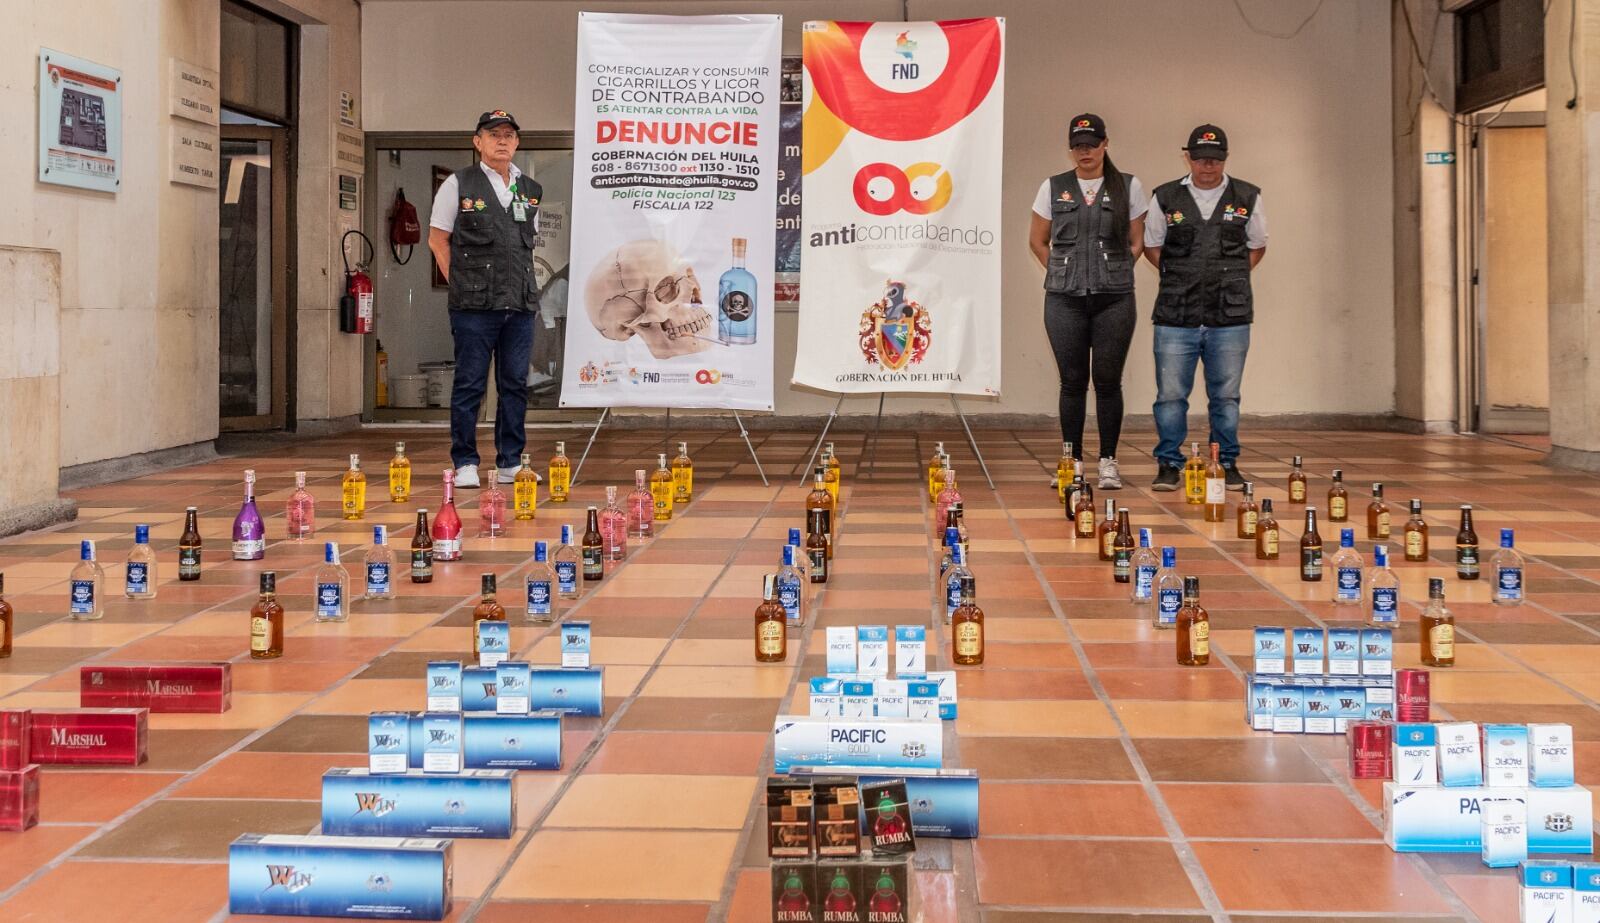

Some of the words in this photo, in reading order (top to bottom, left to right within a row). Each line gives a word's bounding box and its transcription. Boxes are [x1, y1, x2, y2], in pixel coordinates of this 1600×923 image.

[588, 63, 689, 76] COMERCIALIZAR
[692, 67, 700, 77] Y
[703, 66, 770, 77] CONSUMIR
[892, 63, 919, 80] FND
[597, 75, 697, 90] CIGARRILLOS
[701, 78, 711, 90] Y
[714, 77, 759, 89] LICOR
[592, 88, 615, 102] DE
[621, 89, 765, 105] CONTRABANDO
[596, 104, 609, 113] ES
[612, 104, 663, 115] ATENTAR
[666, 106, 711, 116] CONTRA
[715, 106, 729, 115] LA
[732, 106, 759, 116] VIDA
[596, 120, 758, 146] DENUNCIE
[591, 150, 688, 162] GOBERNACIÓN
[691, 152, 716, 161] DEL
[720, 151, 759, 164] HUILA
[591, 163, 614, 173] 608
[625, 161, 678, 173] 8671300
[680, 165, 698, 173] ext
[699, 162, 724, 172] 1130
[736, 164, 760, 176] 1510
[594, 175, 756, 189] anticontrabando@huila.gov.co
[656, 189, 715, 200] Nacional
[717, 190, 736, 201] 123
[632, 200, 691, 211] FISCALIA
[694, 200, 714, 211] 122
[809, 219, 994, 248] anticontrabando
[643, 372, 660, 384] FND
[835, 371, 908, 383] GOBERNACIÓN
[910, 373, 931, 382] DEL
[932, 372, 962, 383] HUILA
[862, 642, 883, 650] PACIFIC
[146, 679, 196, 696] MARSHAL
[51, 727, 107, 746] MARSHAL
[830, 728, 887, 743] PACIFIC
[847, 744, 870, 754] GOLD
[1404, 749, 1430, 757] PACIFIC
[1447, 745, 1474, 755] PACIFIC
[1541, 747, 1567, 756] PACIFIC
[1495, 757, 1522, 766] PACIFIC
[1494, 825, 1521, 835] PACIFIC
[875, 831, 912, 846] RUMBA
[1533, 891, 1565, 900] PACIFIC
[777, 911, 813, 921] RUMBA
[824, 911, 860, 922] RUMBA
[868, 911, 905, 923] RUMBA
